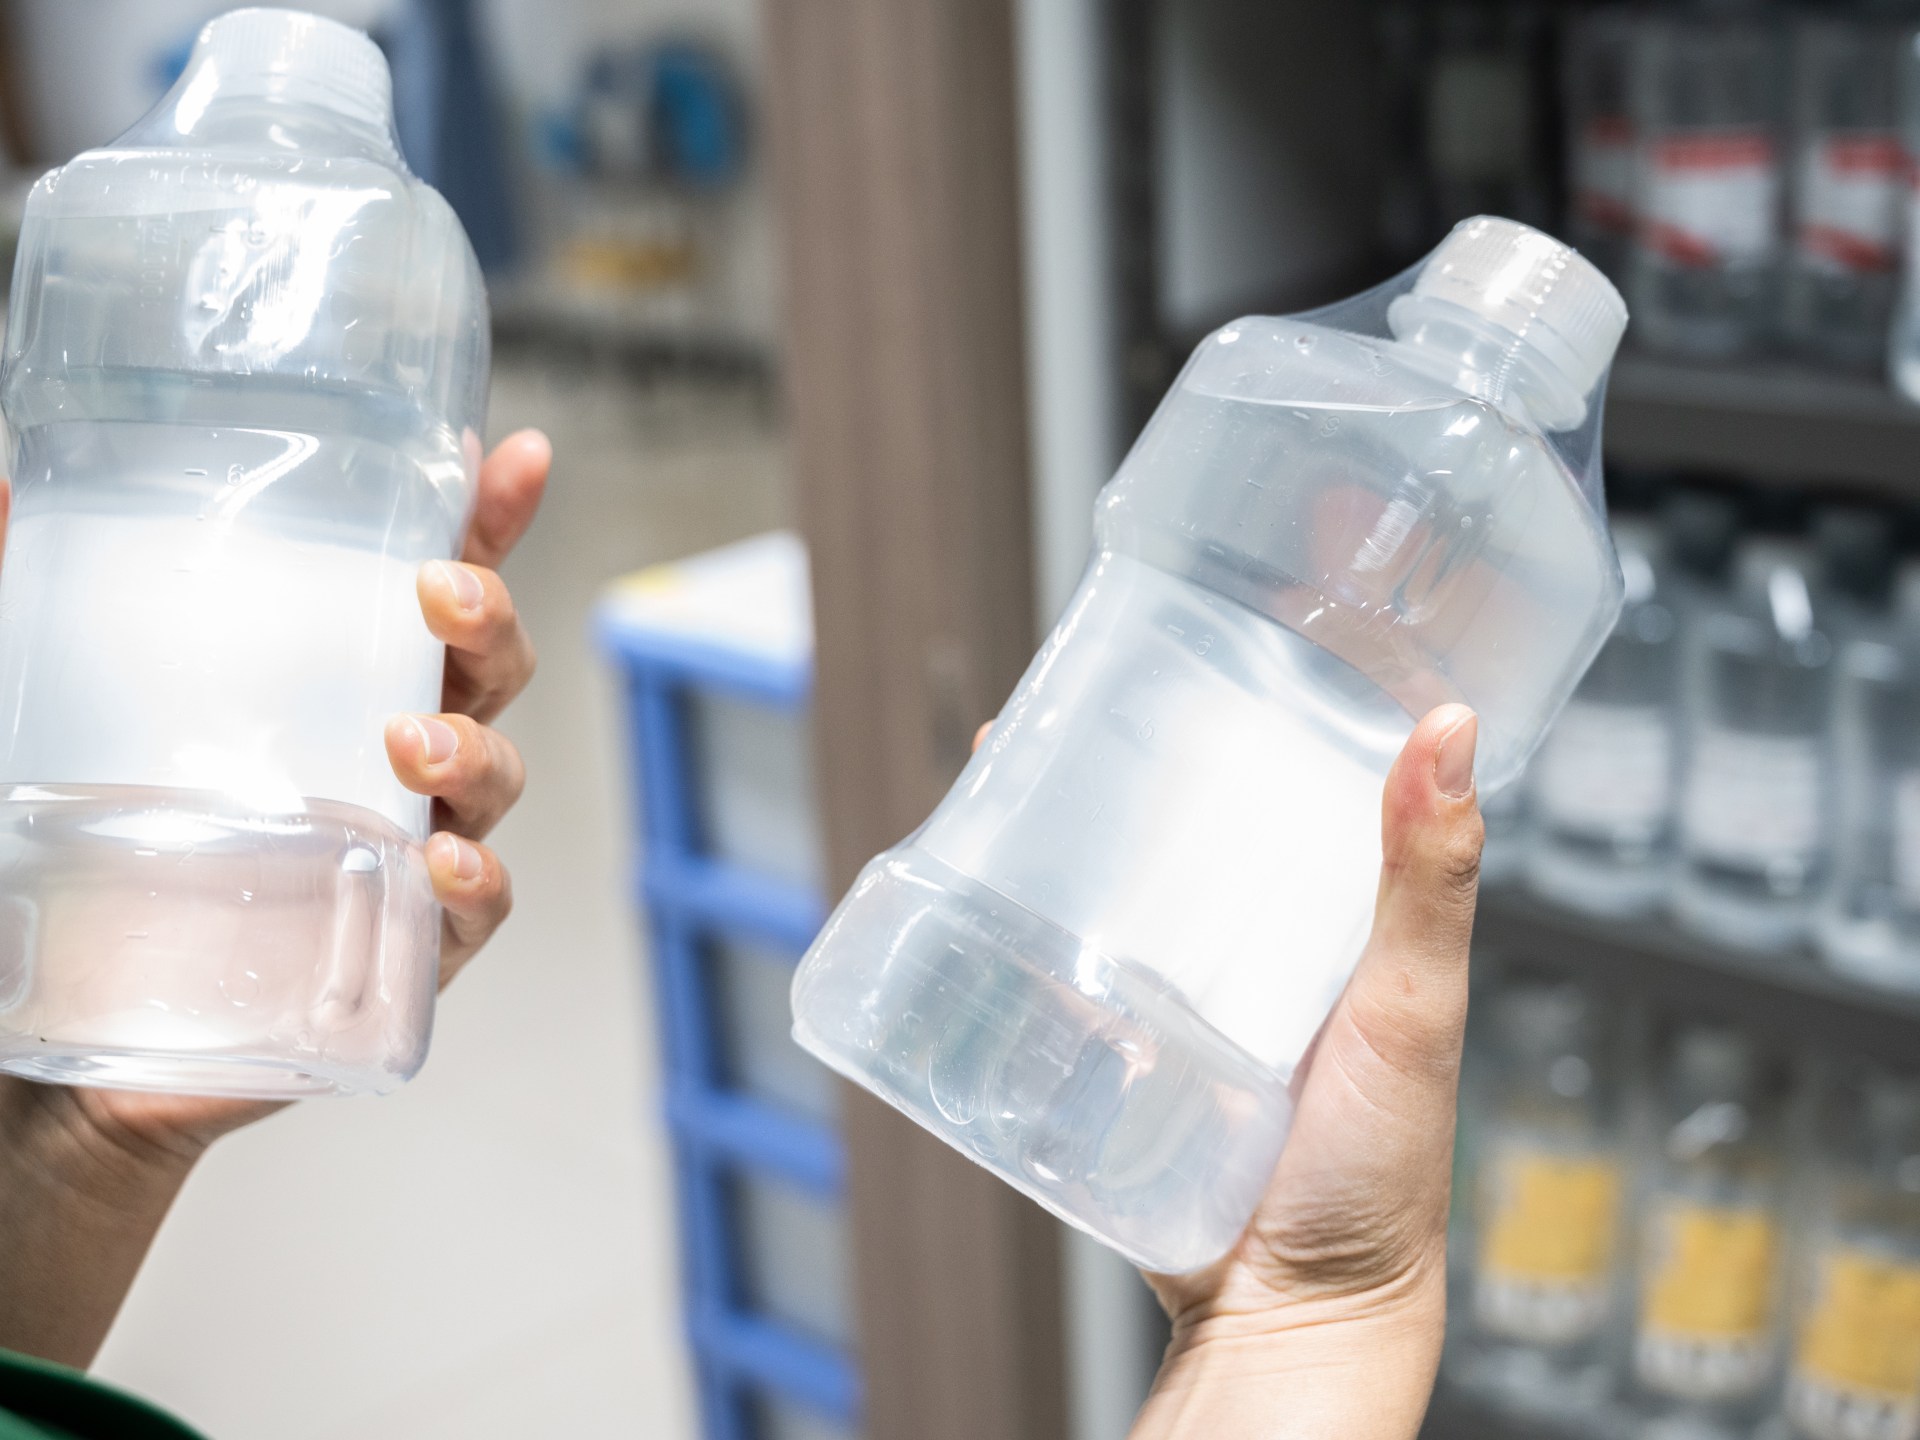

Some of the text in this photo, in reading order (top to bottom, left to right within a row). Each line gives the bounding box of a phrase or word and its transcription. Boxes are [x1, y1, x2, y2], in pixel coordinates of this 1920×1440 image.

[1319, 415, 1342, 438] 9
[226, 462, 245, 486] 6
[176, 840, 197, 866] 2
